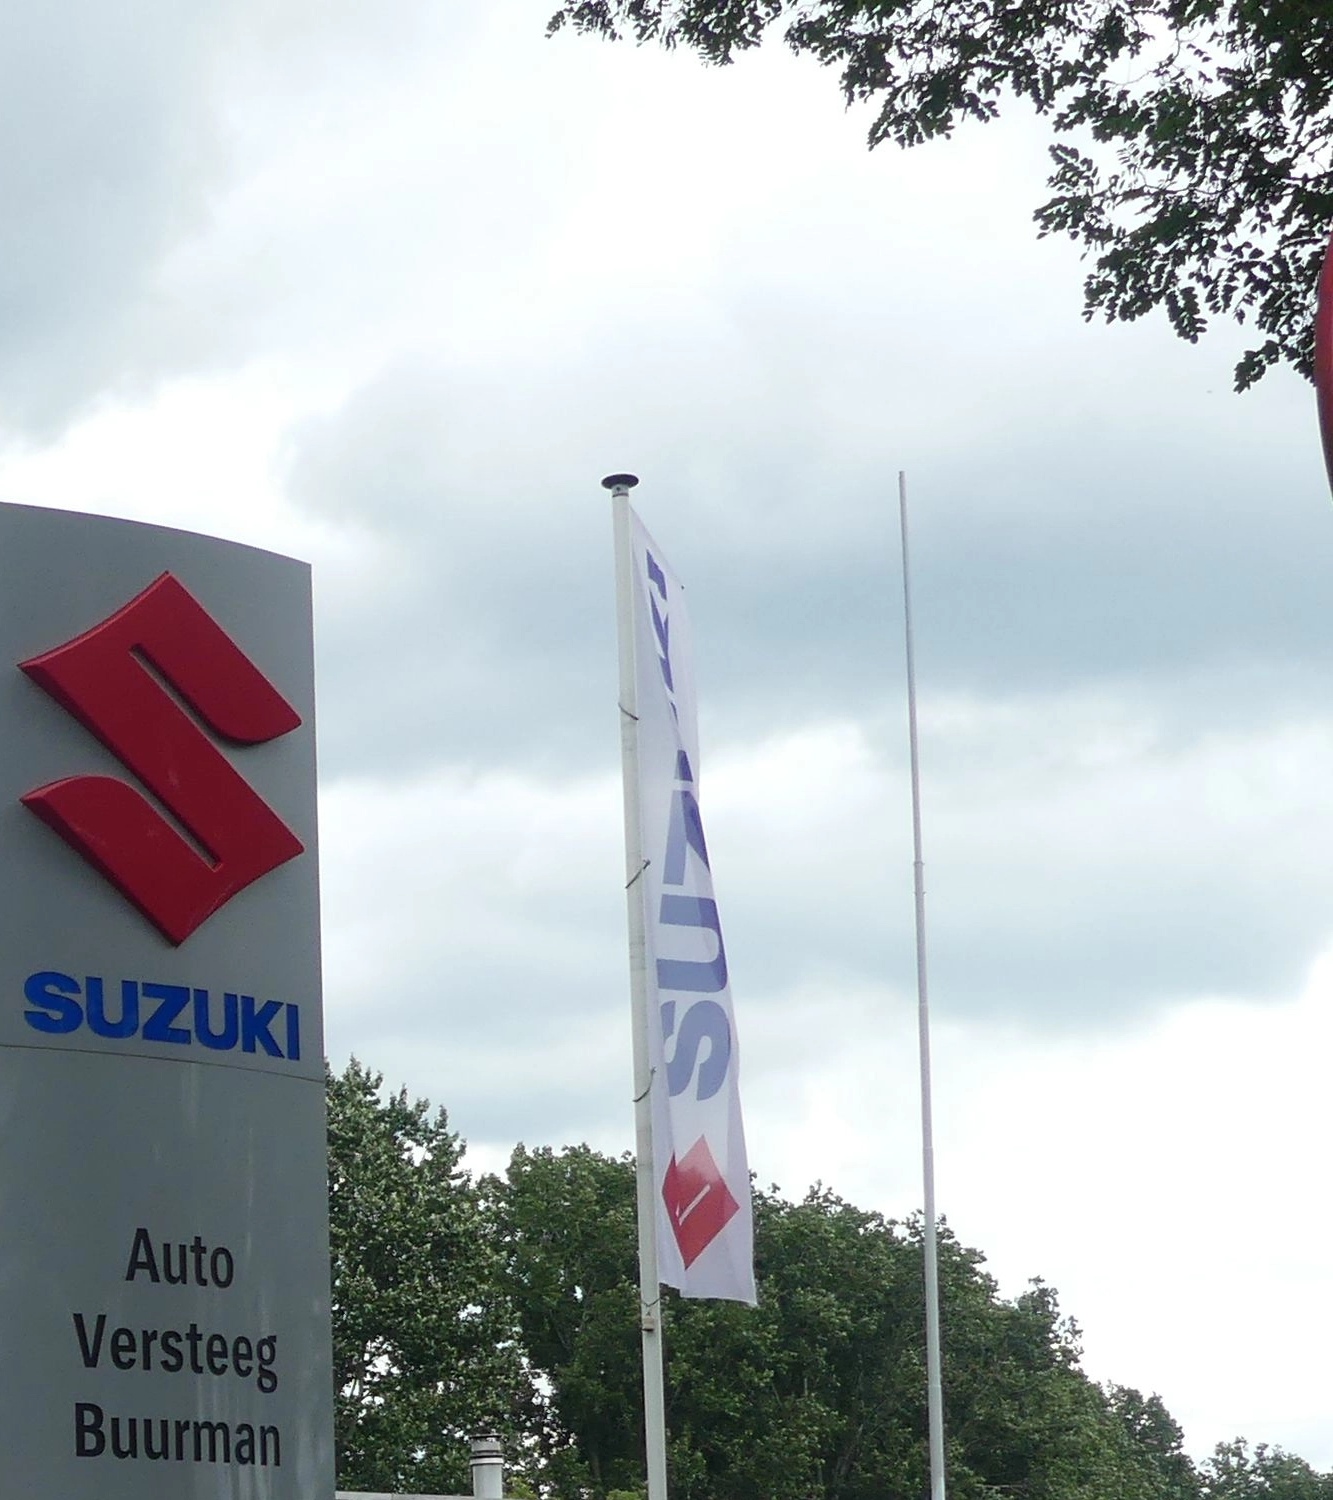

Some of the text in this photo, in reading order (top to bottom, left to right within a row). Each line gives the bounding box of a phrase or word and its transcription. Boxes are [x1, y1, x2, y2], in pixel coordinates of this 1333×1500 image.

[24, 971, 301, 1061] SUZUKI
[125, 1227, 234, 1289] Auto
[72, 1312, 279, 1394] Versteeg
[75, 1402, 281, 1467] Buurman
